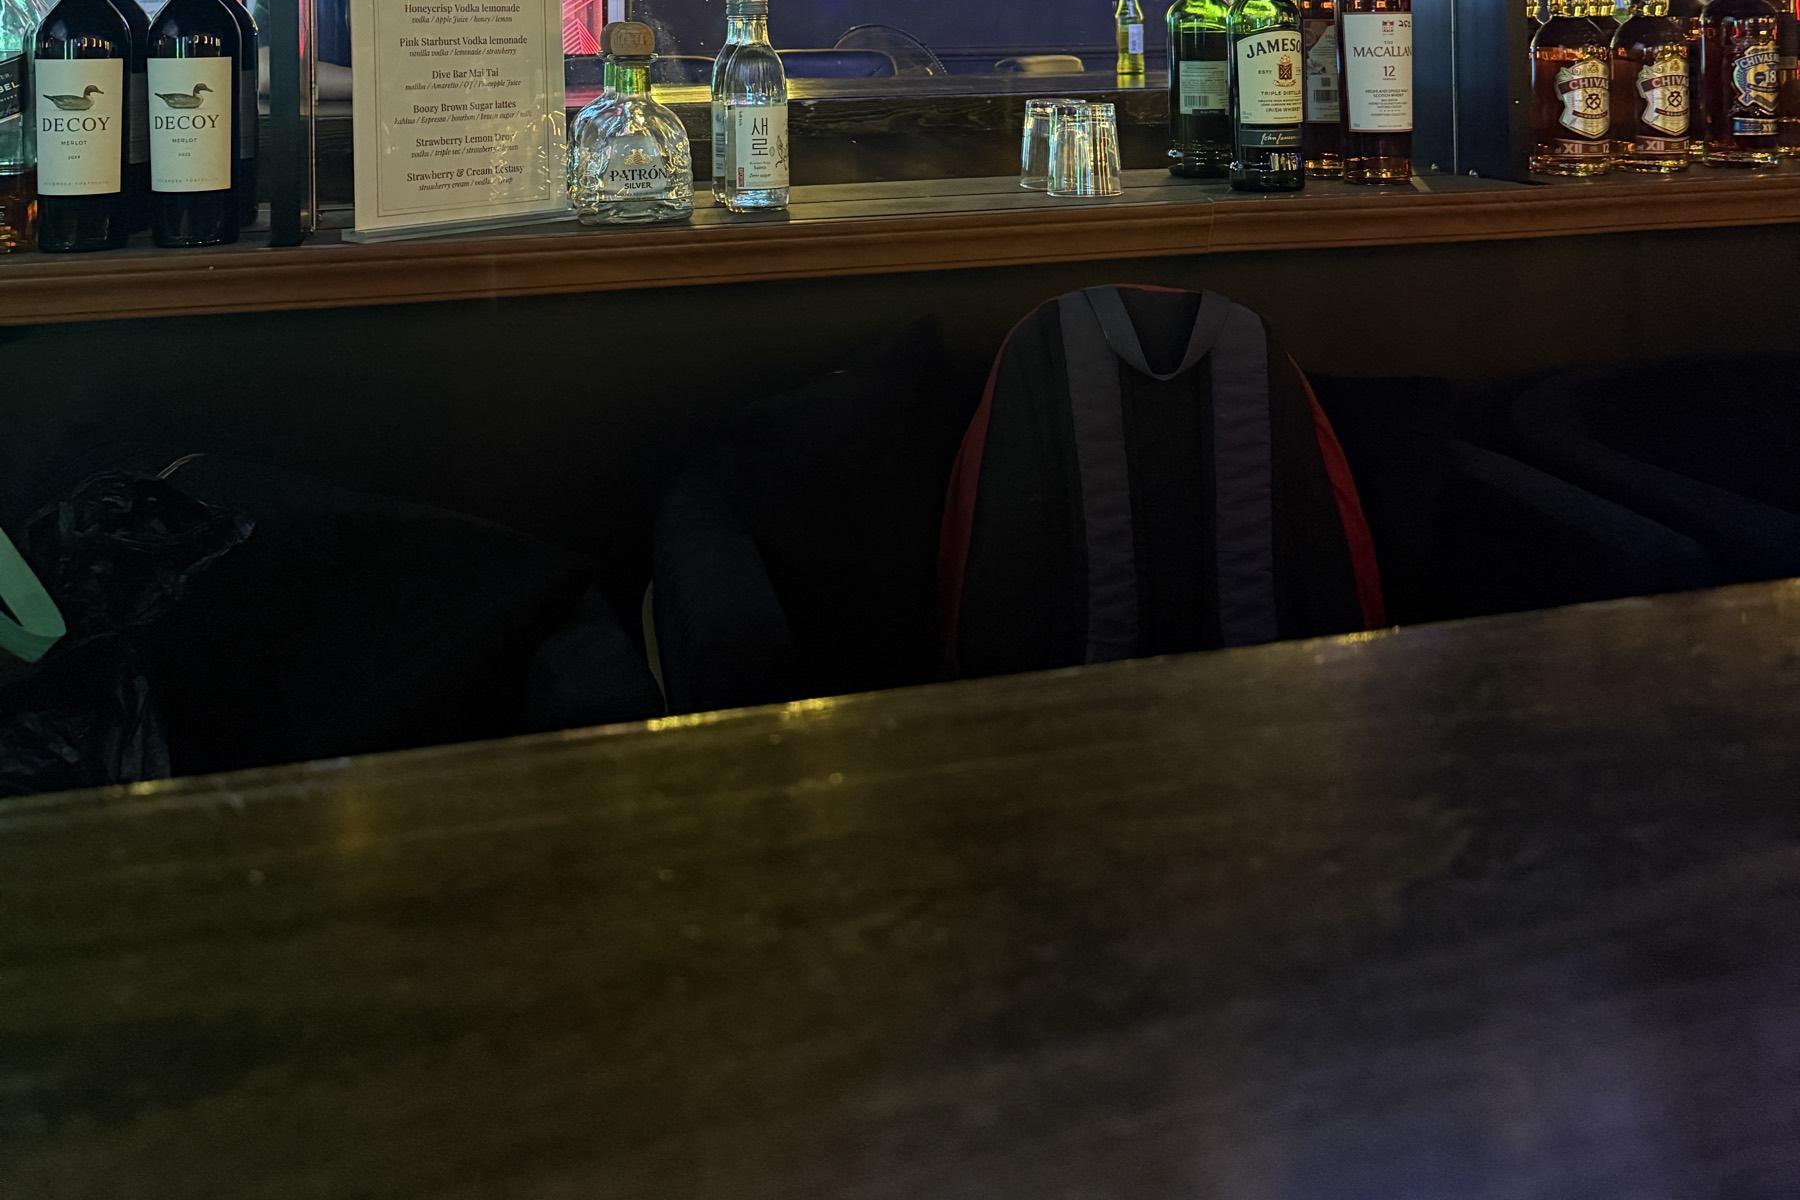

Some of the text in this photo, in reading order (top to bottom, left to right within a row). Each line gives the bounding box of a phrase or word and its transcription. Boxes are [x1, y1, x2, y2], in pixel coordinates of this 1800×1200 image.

[404, 3, 520, 14] Honeycrisp Vodka lemonade
[412, 15, 430, 24] vodka
[435, 16, 452, 25] Apple
[453, 15, 469, 24] Juice
[400, 35, 528, 47] Pink Starburst Vodka lemonade
[431, 68, 499, 79] Dive Bar Mai Tai
[1383, 65, 1396, 77] 12
[1765, 70, 1777, 83] 18
[413, 100, 517, 114] Boozy Brown Sugar lattes
[42, 116, 110, 132] DECOY
[154, 114, 219, 130] DECOY
[416, 136, 462, 147] Strawberry
[465, 134, 493, 143] Lemon
[751, 117, 768, 156] 새로
[406, 171, 454, 182] Strawberry
[456, 168, 465, 177] &
[466, 167, 493, 177] Cream
[609, 164, 669, 181] PATRÓN
[624, 182, 653, 190] SILVER
